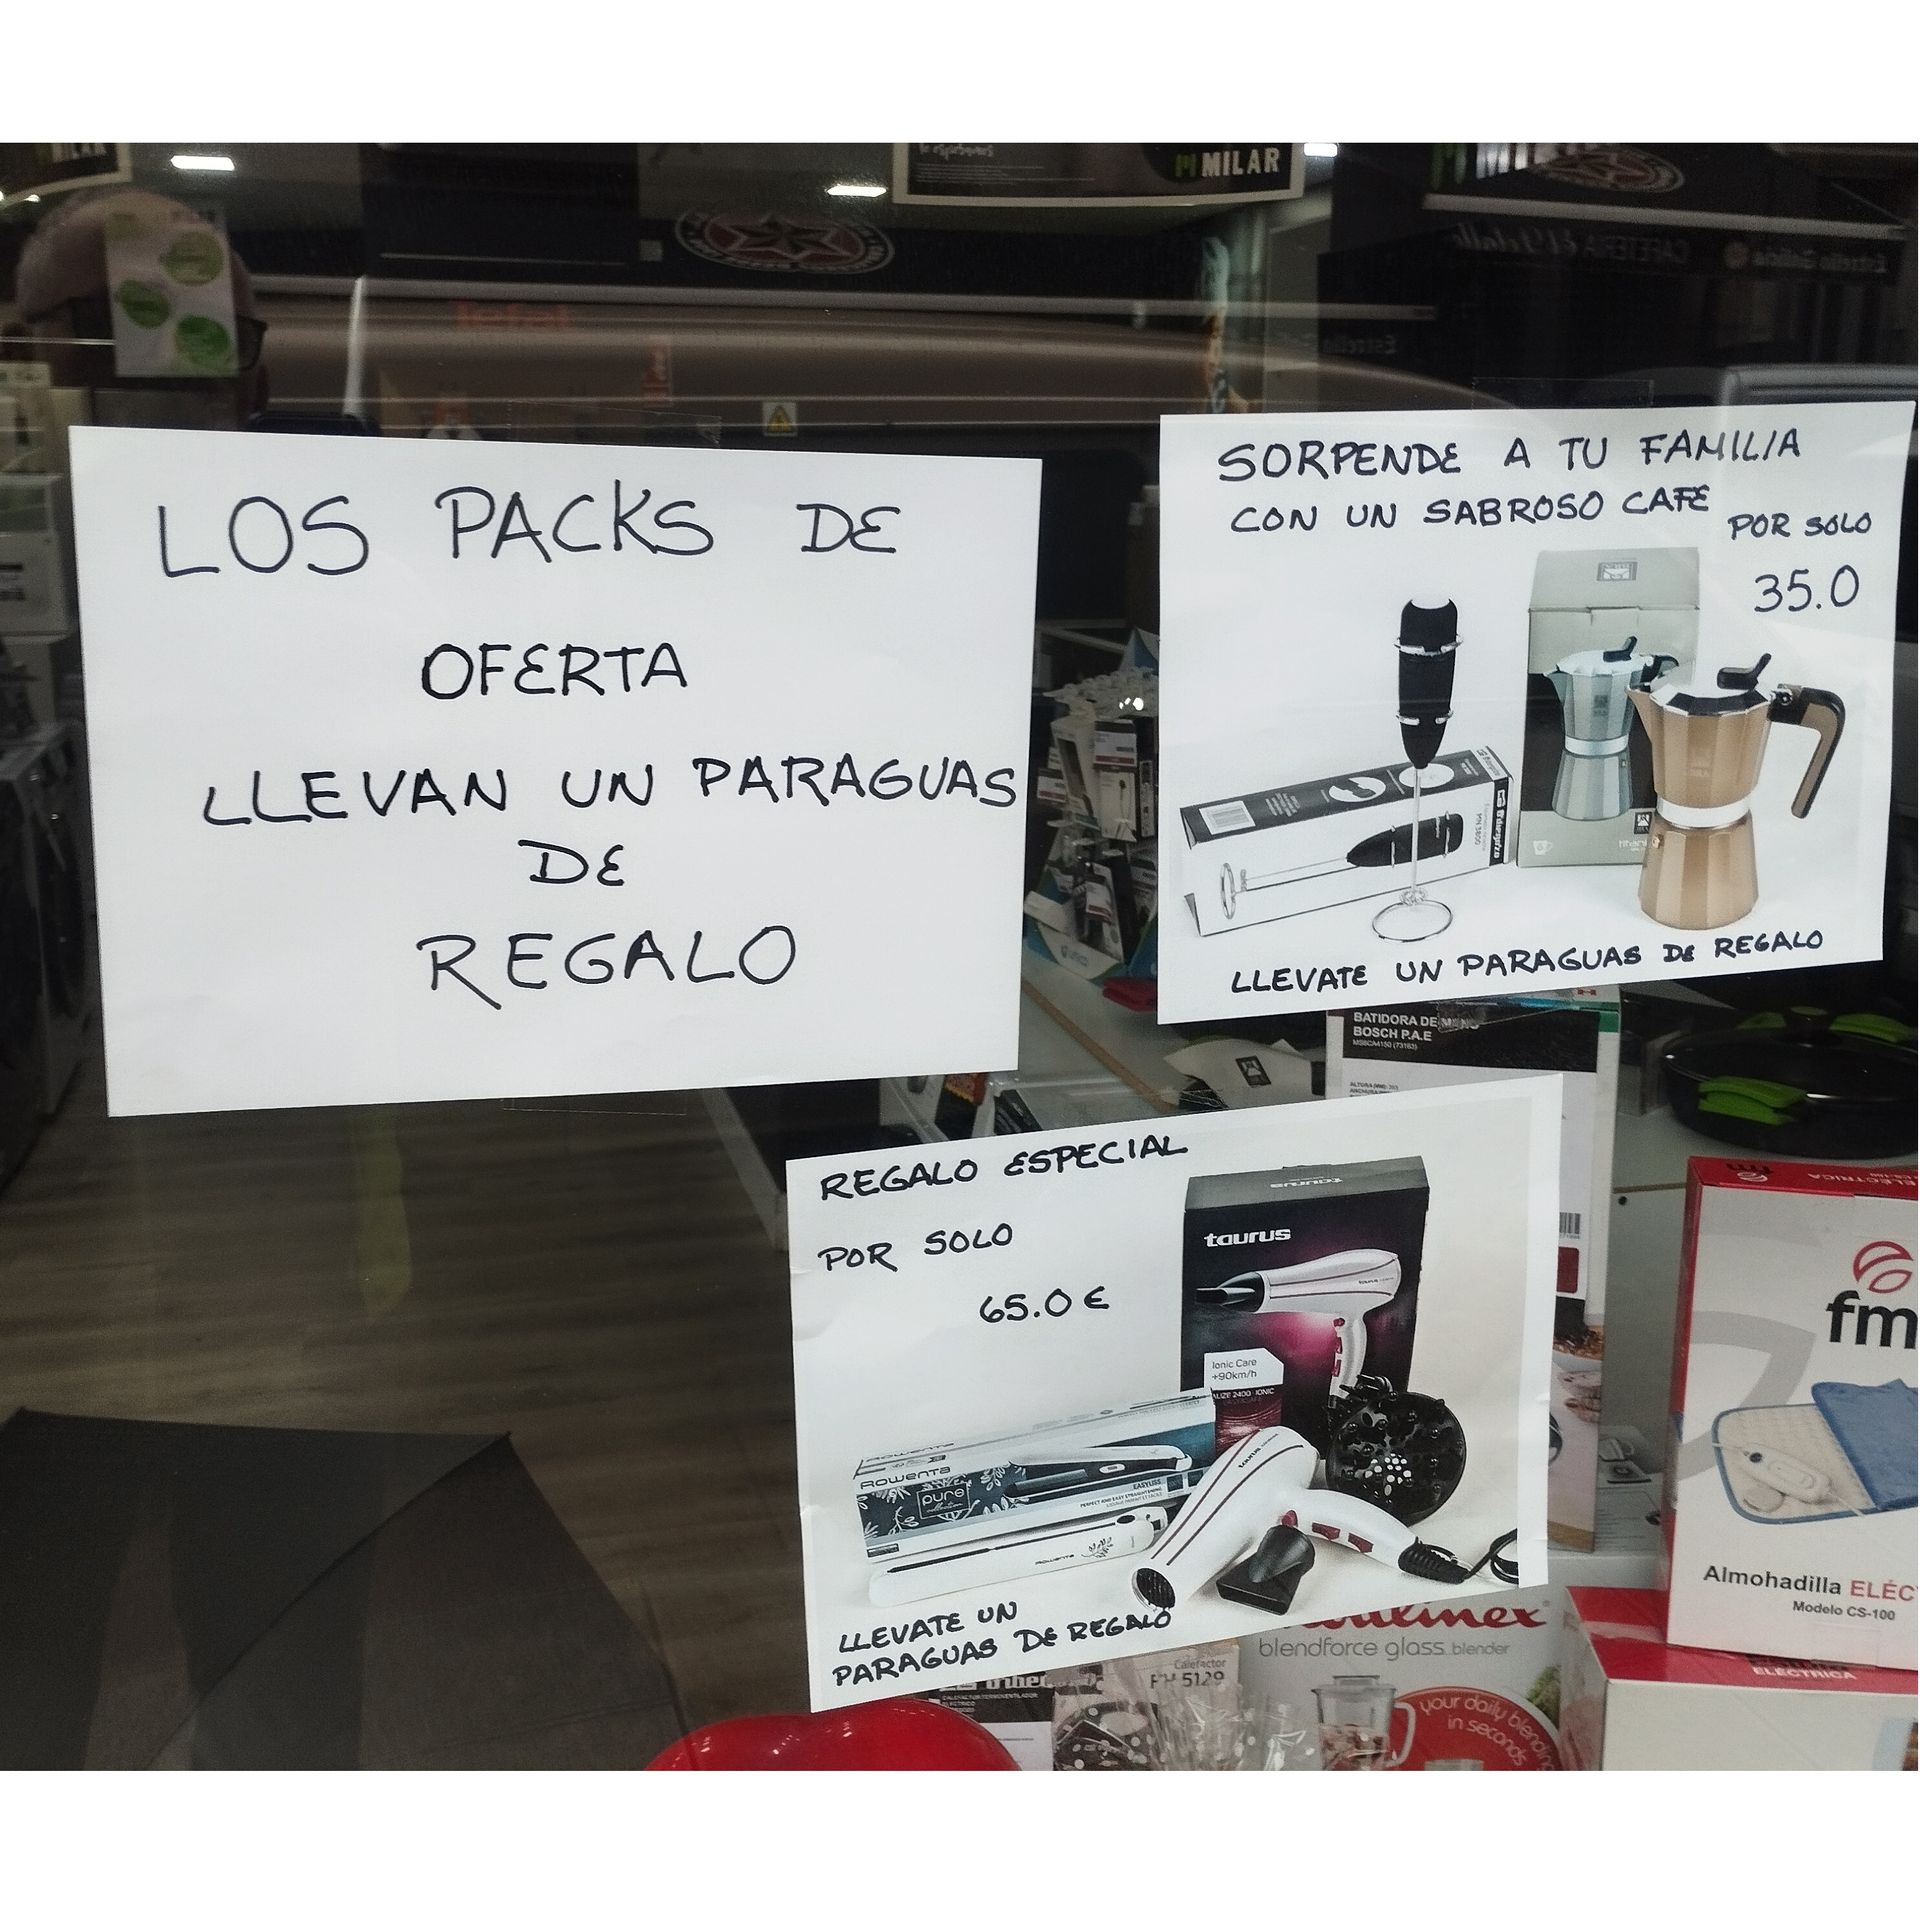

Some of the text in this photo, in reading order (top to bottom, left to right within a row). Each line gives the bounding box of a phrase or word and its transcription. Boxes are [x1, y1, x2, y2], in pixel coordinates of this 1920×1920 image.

[1201, 148, 1281, 177] MILAR
[1218, 428, 1801, 482] SORPENDE A TU FAMILIA
[158, 479, 901, 578] LOS PACKS DE
[1230, 505, 1318, 533] CON
[1346, 503, 1397, 529] UN
[1423, 490, 1604, 527] SABROSO
[1727, 512, 1872, 541] POR SOLO
[1754, 564, 1860, 613] 35.0
[421, 642, 688, 700] OFERTA
[203, 752, 1017, 826] LLEVAN UN PARAGUAS
[517, 839, 625, 887] DE
[416, 925, 796, 1011] REGALO
[1231, 929, 1823, 994] LLEVATE UN PARAGUAS DE REGALO
[1353, 1011, 1417, 1028] BATIDORA
[1419, 1015, 1438, 1028] DE
[1353, 1025, 1432, 1042] BOSCH P.A.E
[819, 1136, 1190, 1201] REGALO ESPECIAL
[817, 1222, 1013, 1273] POR SOLO
[1204, 1228, 1292, 1248] taurus
[979, 1285, 1110, 1324] 65.0 €
[1212, 1358, 1258, 1369] Ionic Care
[1212, 1370, 1258, 1381] +90km/h
[922, 1487, 966, 1506] pure
[1703, 1565, 1918, 1602] Almohadilla ELÉC
[839, 1601, 1017, 1653] LLEVATE UN
[1792, 1600, 1896, 1621] Modelo CS-100
[832, 1638, 998, 1687] PARAGUAS
[1013, 1628, 1058, 1653] DE
[1066, 1611, 1172, 1642] REGALO
[1258, 1636, 1511, 1662] blendforce glass blender
[1419, 1696, 1460, 1718] your
[1464, 1696, 1507, 1721] daily
[1448, 1715, 1528, 1767] in seconds
